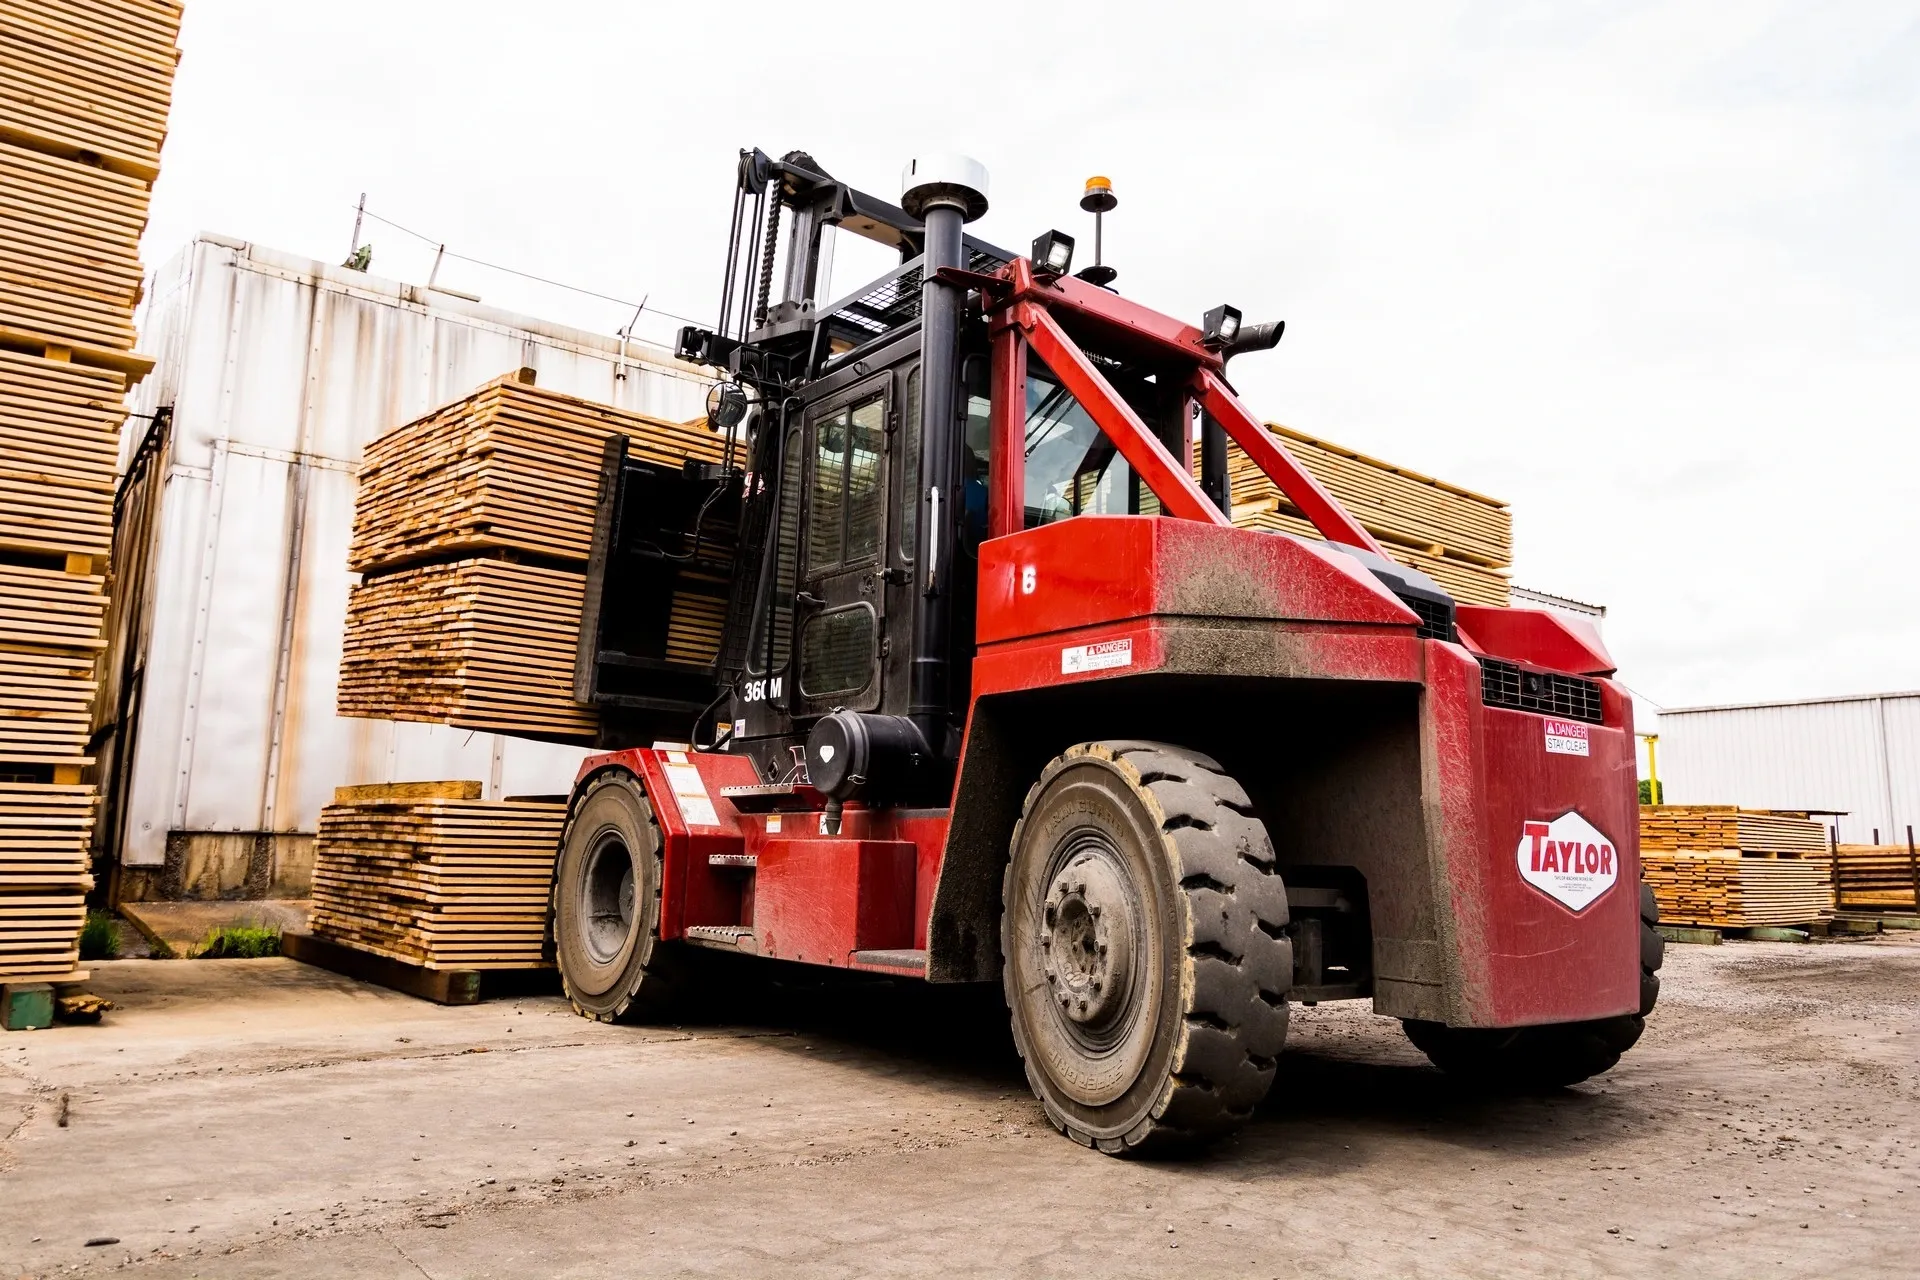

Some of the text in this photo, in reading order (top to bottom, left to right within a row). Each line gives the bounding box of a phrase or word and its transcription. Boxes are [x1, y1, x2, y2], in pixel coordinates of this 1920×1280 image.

[1022, 564, 1036, 595] 6
[1096, 641, 1129, 655] DANGER
[1087, 657, 1122, 669] STAY CLEAR
[1555, 723, 1587, 738] DANGER
[1547, 737, 1587, 752] STAY CLEAR
[1525, 823, 1612, 875] TAYLOR
